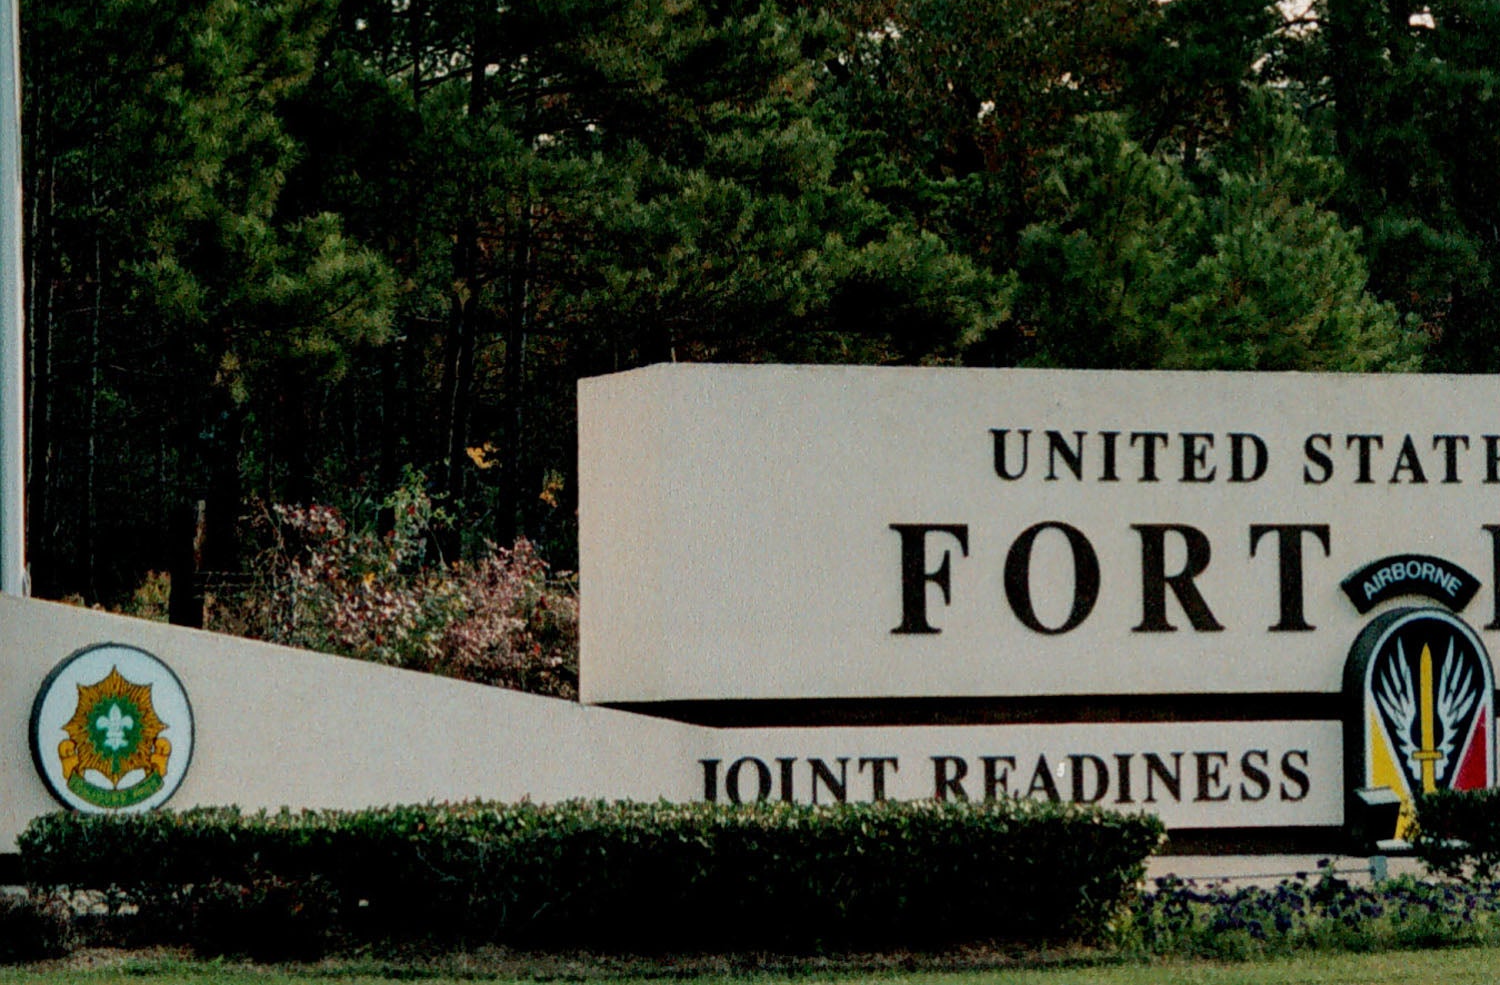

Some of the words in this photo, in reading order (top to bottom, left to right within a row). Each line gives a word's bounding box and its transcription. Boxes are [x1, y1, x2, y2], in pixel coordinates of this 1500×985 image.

[988, 428, 1270, 483] UNITED
[888, 519, 1333, 636] FORT
[1362, 560, 1464, 601] AIRBORNE
[697, 756, 900, 804] JOINT
[930, 749, 1312, 805] READINESS
